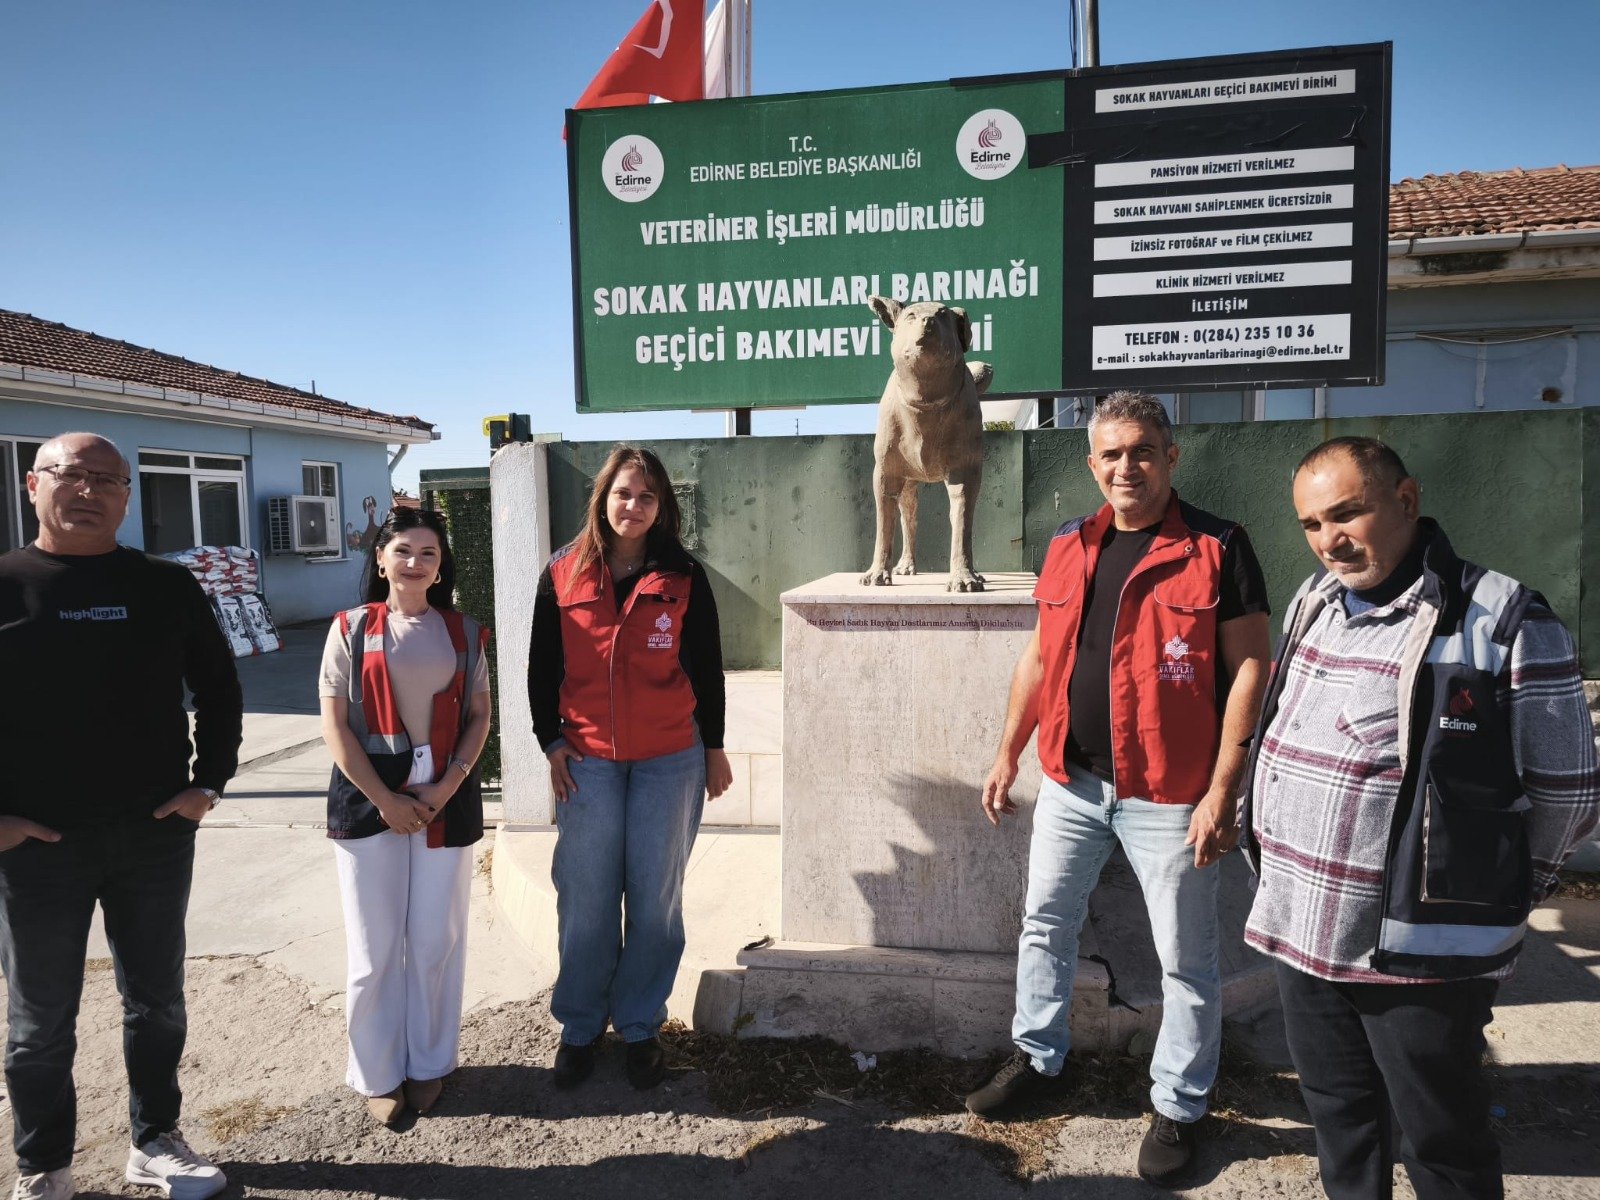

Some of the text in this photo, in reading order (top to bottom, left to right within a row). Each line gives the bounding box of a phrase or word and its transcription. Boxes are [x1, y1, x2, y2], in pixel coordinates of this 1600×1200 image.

[1113, 74, 1338, 105] SOKAK HAYVANLARI GEÇİCİ BAKIMEVİ BİRİMİ
[788, 136, 818, 153] T.C.
[690, 148, 922, 182] EDİRNE BELEDİYE BAŞKANLIĞI
[970, 150, 1011, 162] Edirne
[1150, 157, 1295, 178] PANSİYON HİZMETİ VERİLMEZ
[615, 174, 652, 186] Edirne
[1114, 192, 1332, 218] SOKAK HAYVANI SAHİPLENMEK ÜCRETSİZDİR
[640, 197, 985, 246] VETERİNER İŞLERİ MÜDÜRLÜĞÜ
[1131, 230, 1313, 252] İZİNSİZ FOTOĞRAF ve FİLM ÇEKİLMEZ
[594, 258, 1039, 316] SOKAK HAYVANLARI BARINAĞI
[1156, 271, 1285, 289] KLİNİK HİZMETİ VERİLMEZ
[1192, 298, 1248, 314] İLETİŞİM
[636, 318, 881, 371] GEÇİCİ BAKIMEVİ
[1125, 330, 1180, 346] TELEFON
[1193, 328, 1240, 344] 0(284)
[1244, 326, 1270, 340] 235
[1276, 325, 1292, 340] 10
[1298, 324, 1315, 338] 36
[1097, 352, 1130, 364] e-mail
[1138, 344, 1344, 364] sokakhayvanlaribarinagi@edirne.bel.tr
[60, 606, 127, 620] highlight
[820, 619, 844, 628] Heykel
[870, 619, 898, 628] Hayvan
[1160, 666, 1194, 674] VAKIFLAR
[1440, 716, 1476, 730] Edirne
